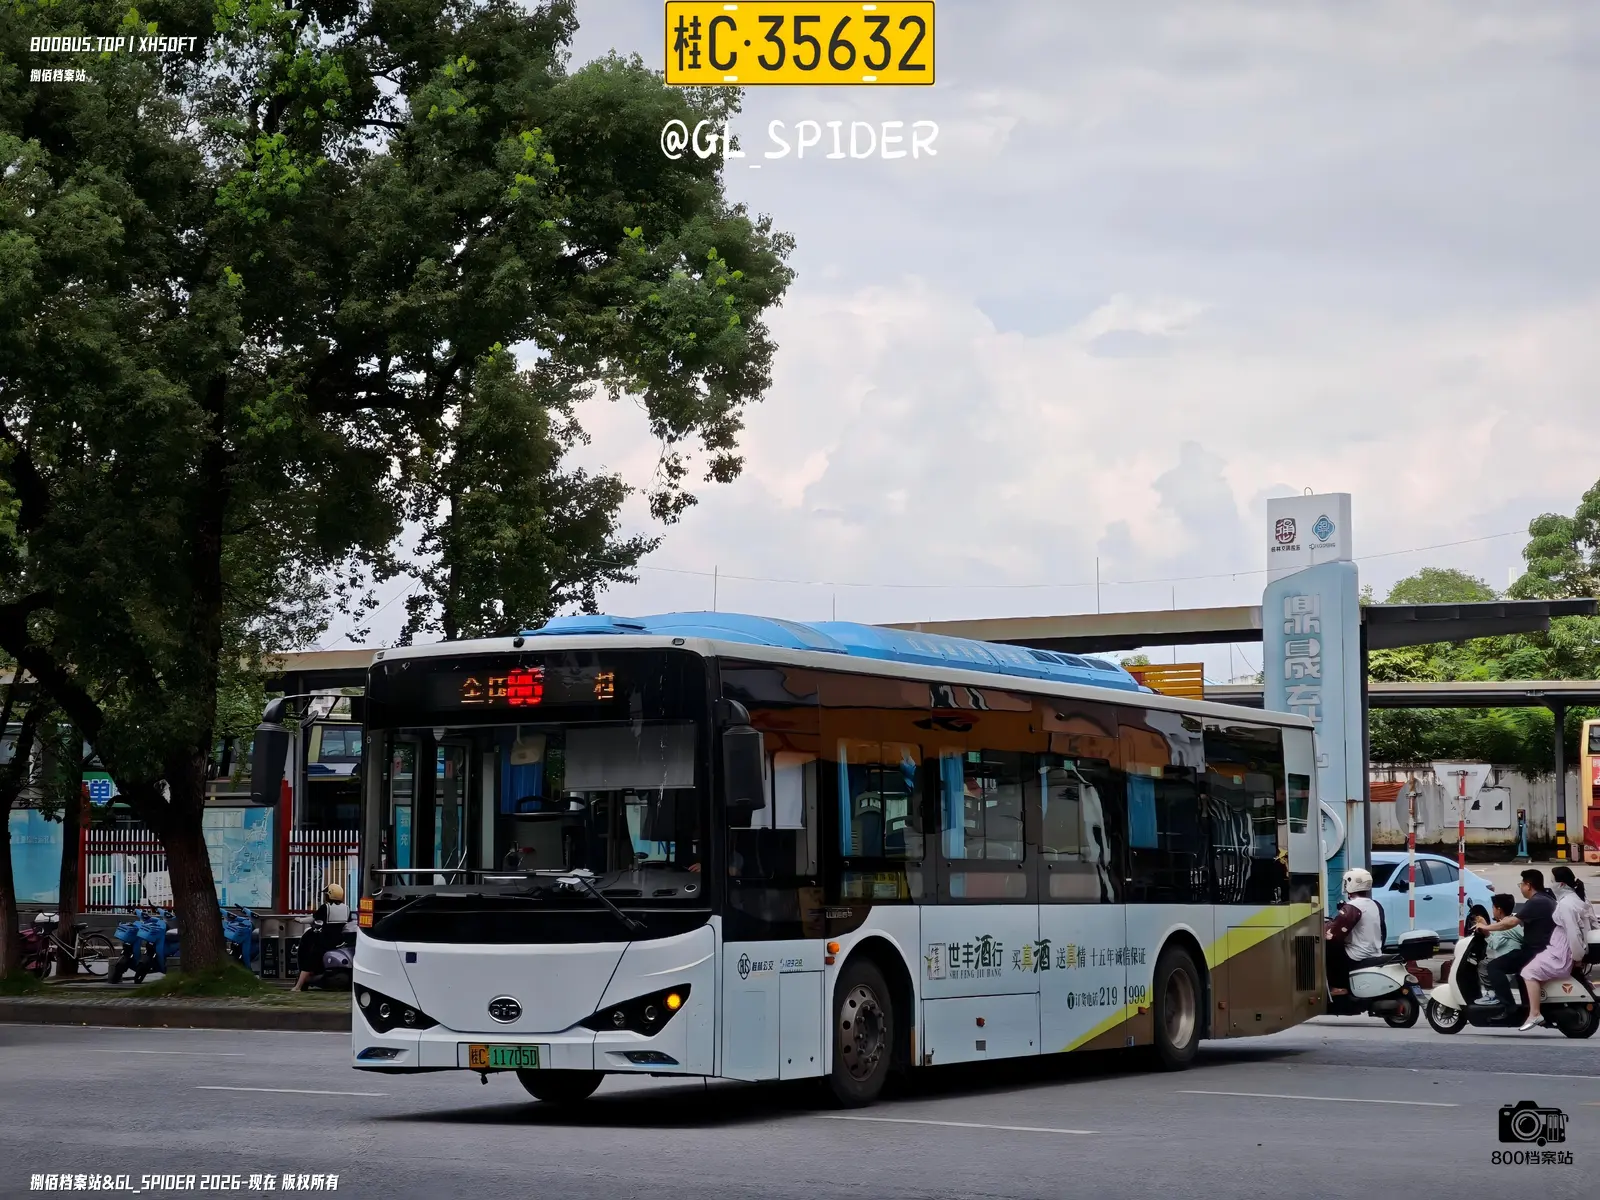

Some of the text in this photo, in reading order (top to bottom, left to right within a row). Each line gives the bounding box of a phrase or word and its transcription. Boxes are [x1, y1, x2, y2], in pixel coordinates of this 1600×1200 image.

[1284, 593, 1328, 767] 鼎晟充
[948, 935, 1003, 968] 世丰酒行
[1012, 939, 1145, 973] 买真酒 送真情 十五年诚信保证
[1099, 986, 1119, 1007] 219
